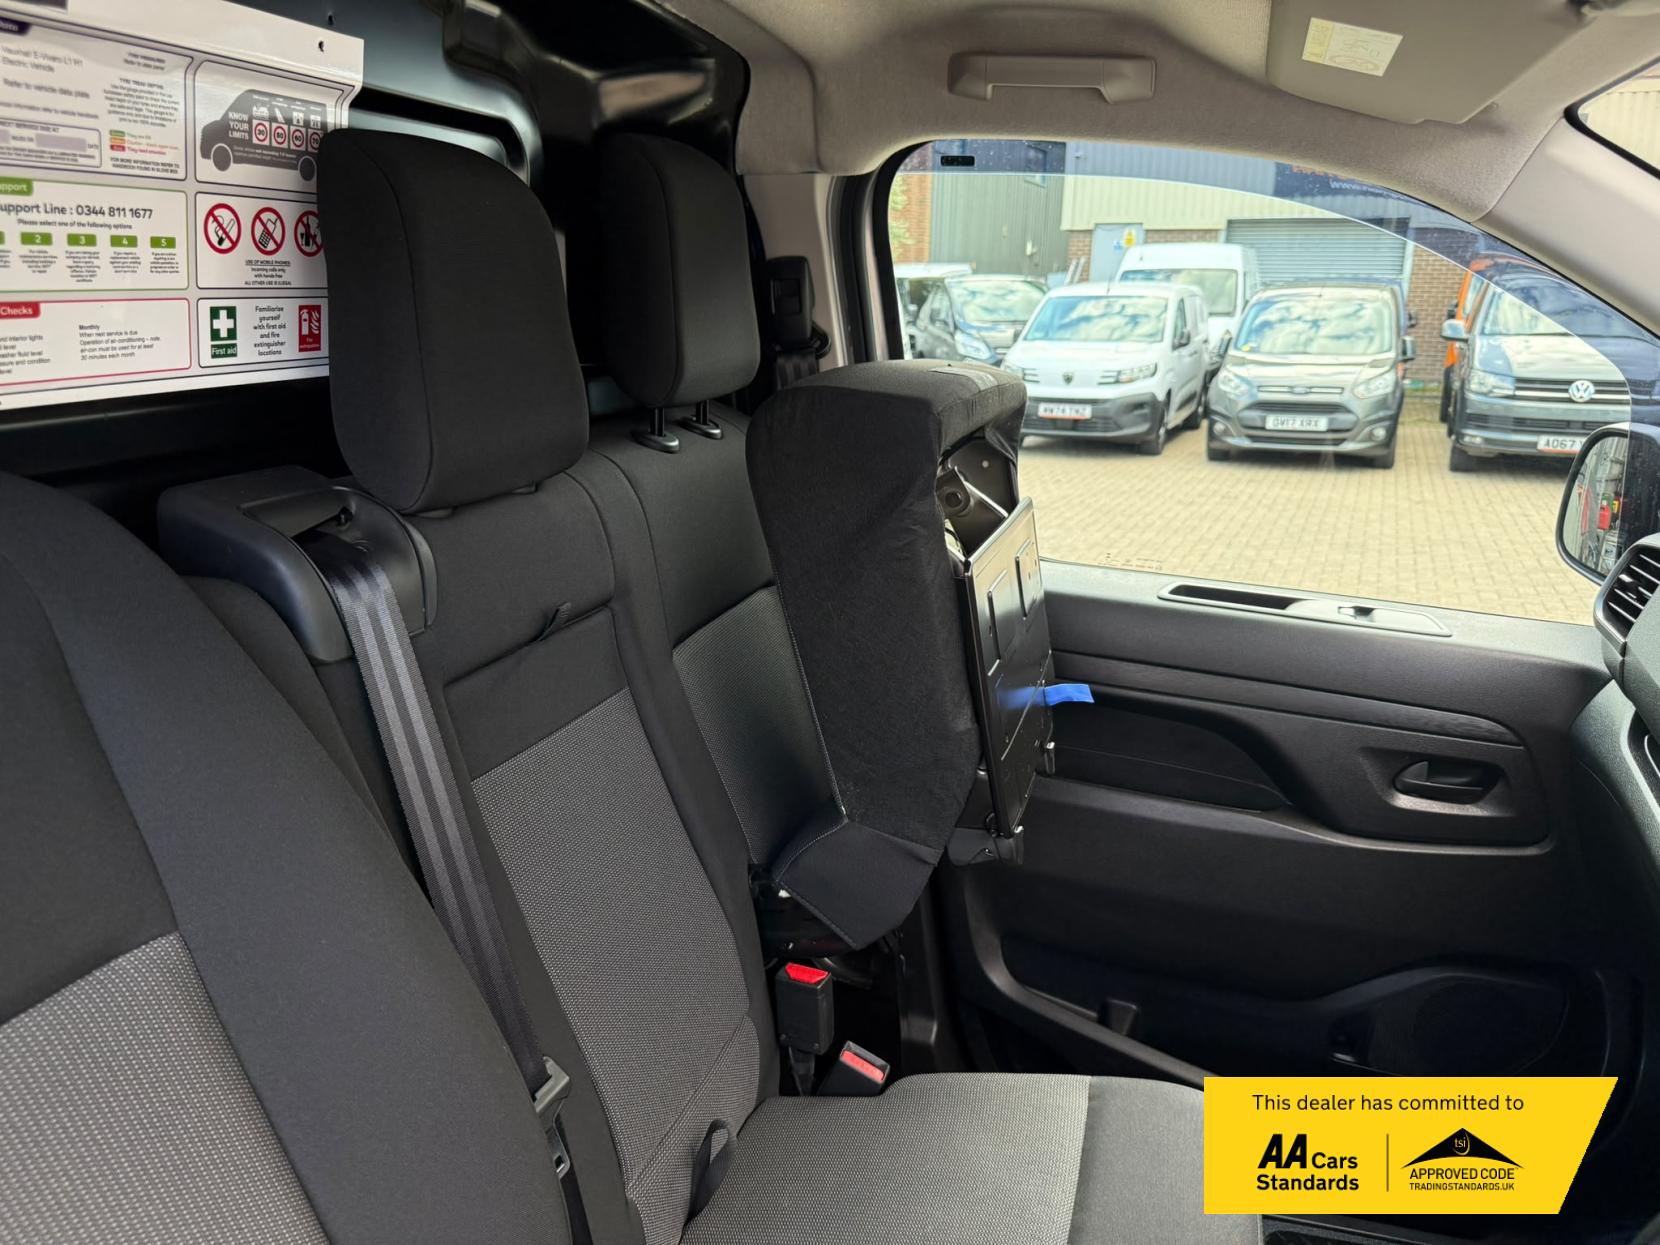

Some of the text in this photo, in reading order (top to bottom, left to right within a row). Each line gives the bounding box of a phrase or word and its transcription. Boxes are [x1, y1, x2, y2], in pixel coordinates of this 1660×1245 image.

[228, 111, 248, 122] KNOW
[229, 120, 249, 131] YOUR
[229, 131, 249, 140] LIMITS
[0, 184, 27, 192] pport
[44, 203, 67, 214] Line
[76, 205, 105, 216] 0344
[108, 206, 126, 218] 811
[129, 208, 153, 219] 1677
[35, 234, 41, 243] 2
[80, 236, 86, 244] 3
[122, 237, 128, 245] 4
[161, 238, 167, 247] 5
[0, 306, 32, 316] Checks
